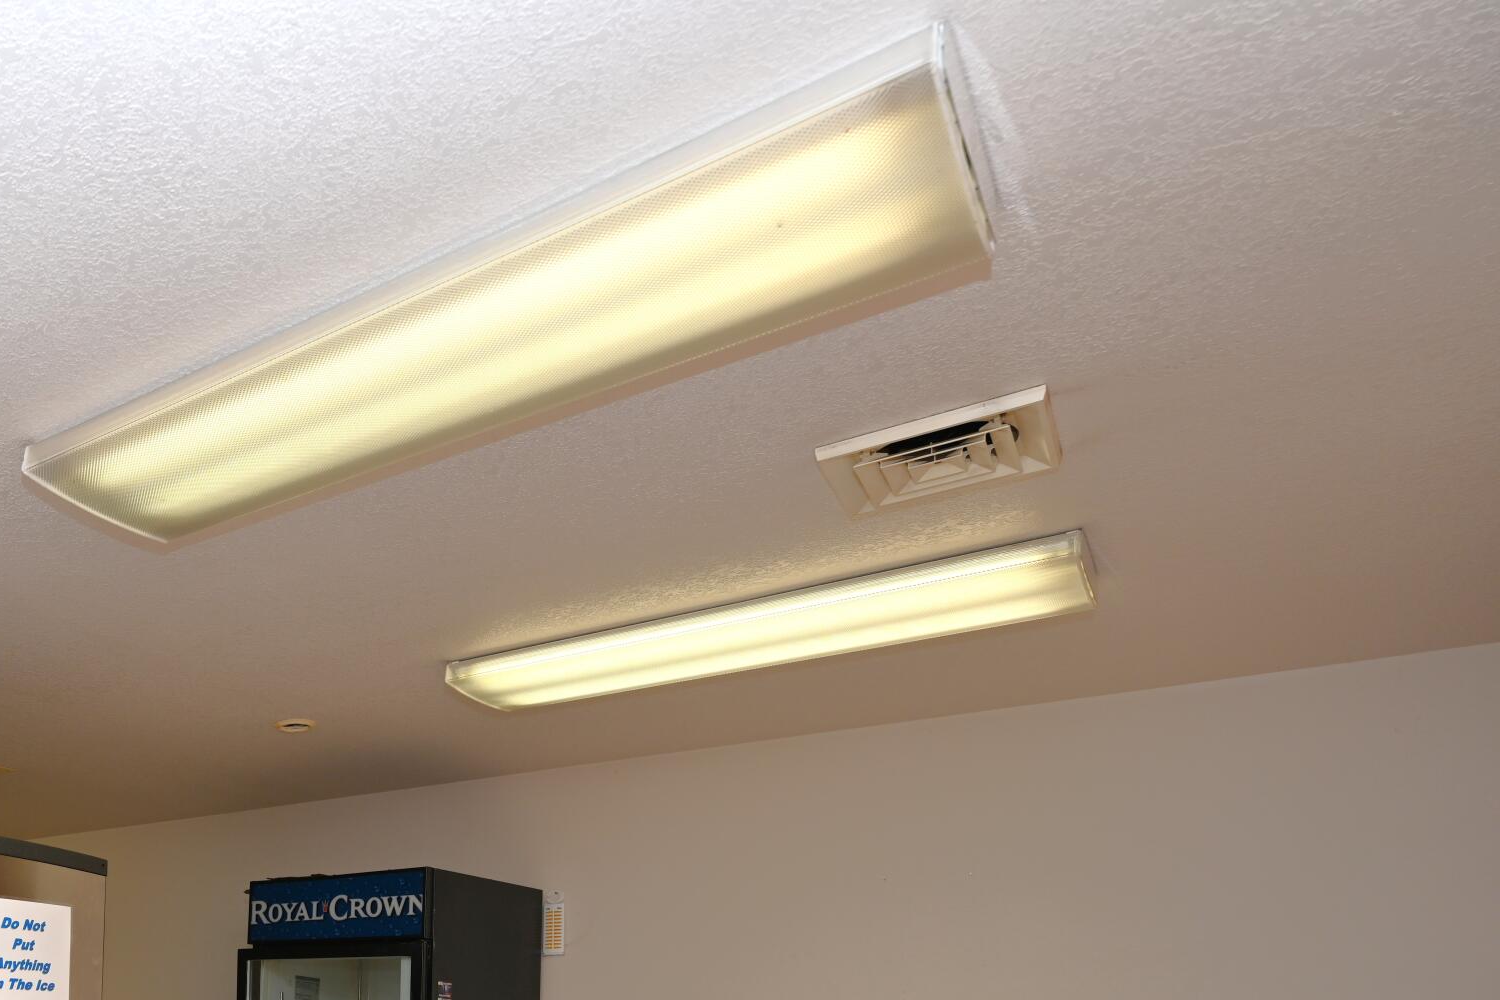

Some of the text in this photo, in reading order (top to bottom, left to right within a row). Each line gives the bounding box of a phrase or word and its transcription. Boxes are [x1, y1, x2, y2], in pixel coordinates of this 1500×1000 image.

[250, 894, 423, 925] ROYAL CROWN
[0, 916, 46, 932] Do Not
[11, 938, 35, 951] Put
[8, 978, 33, 991] The
[35, 980, 56, 992] Ice
